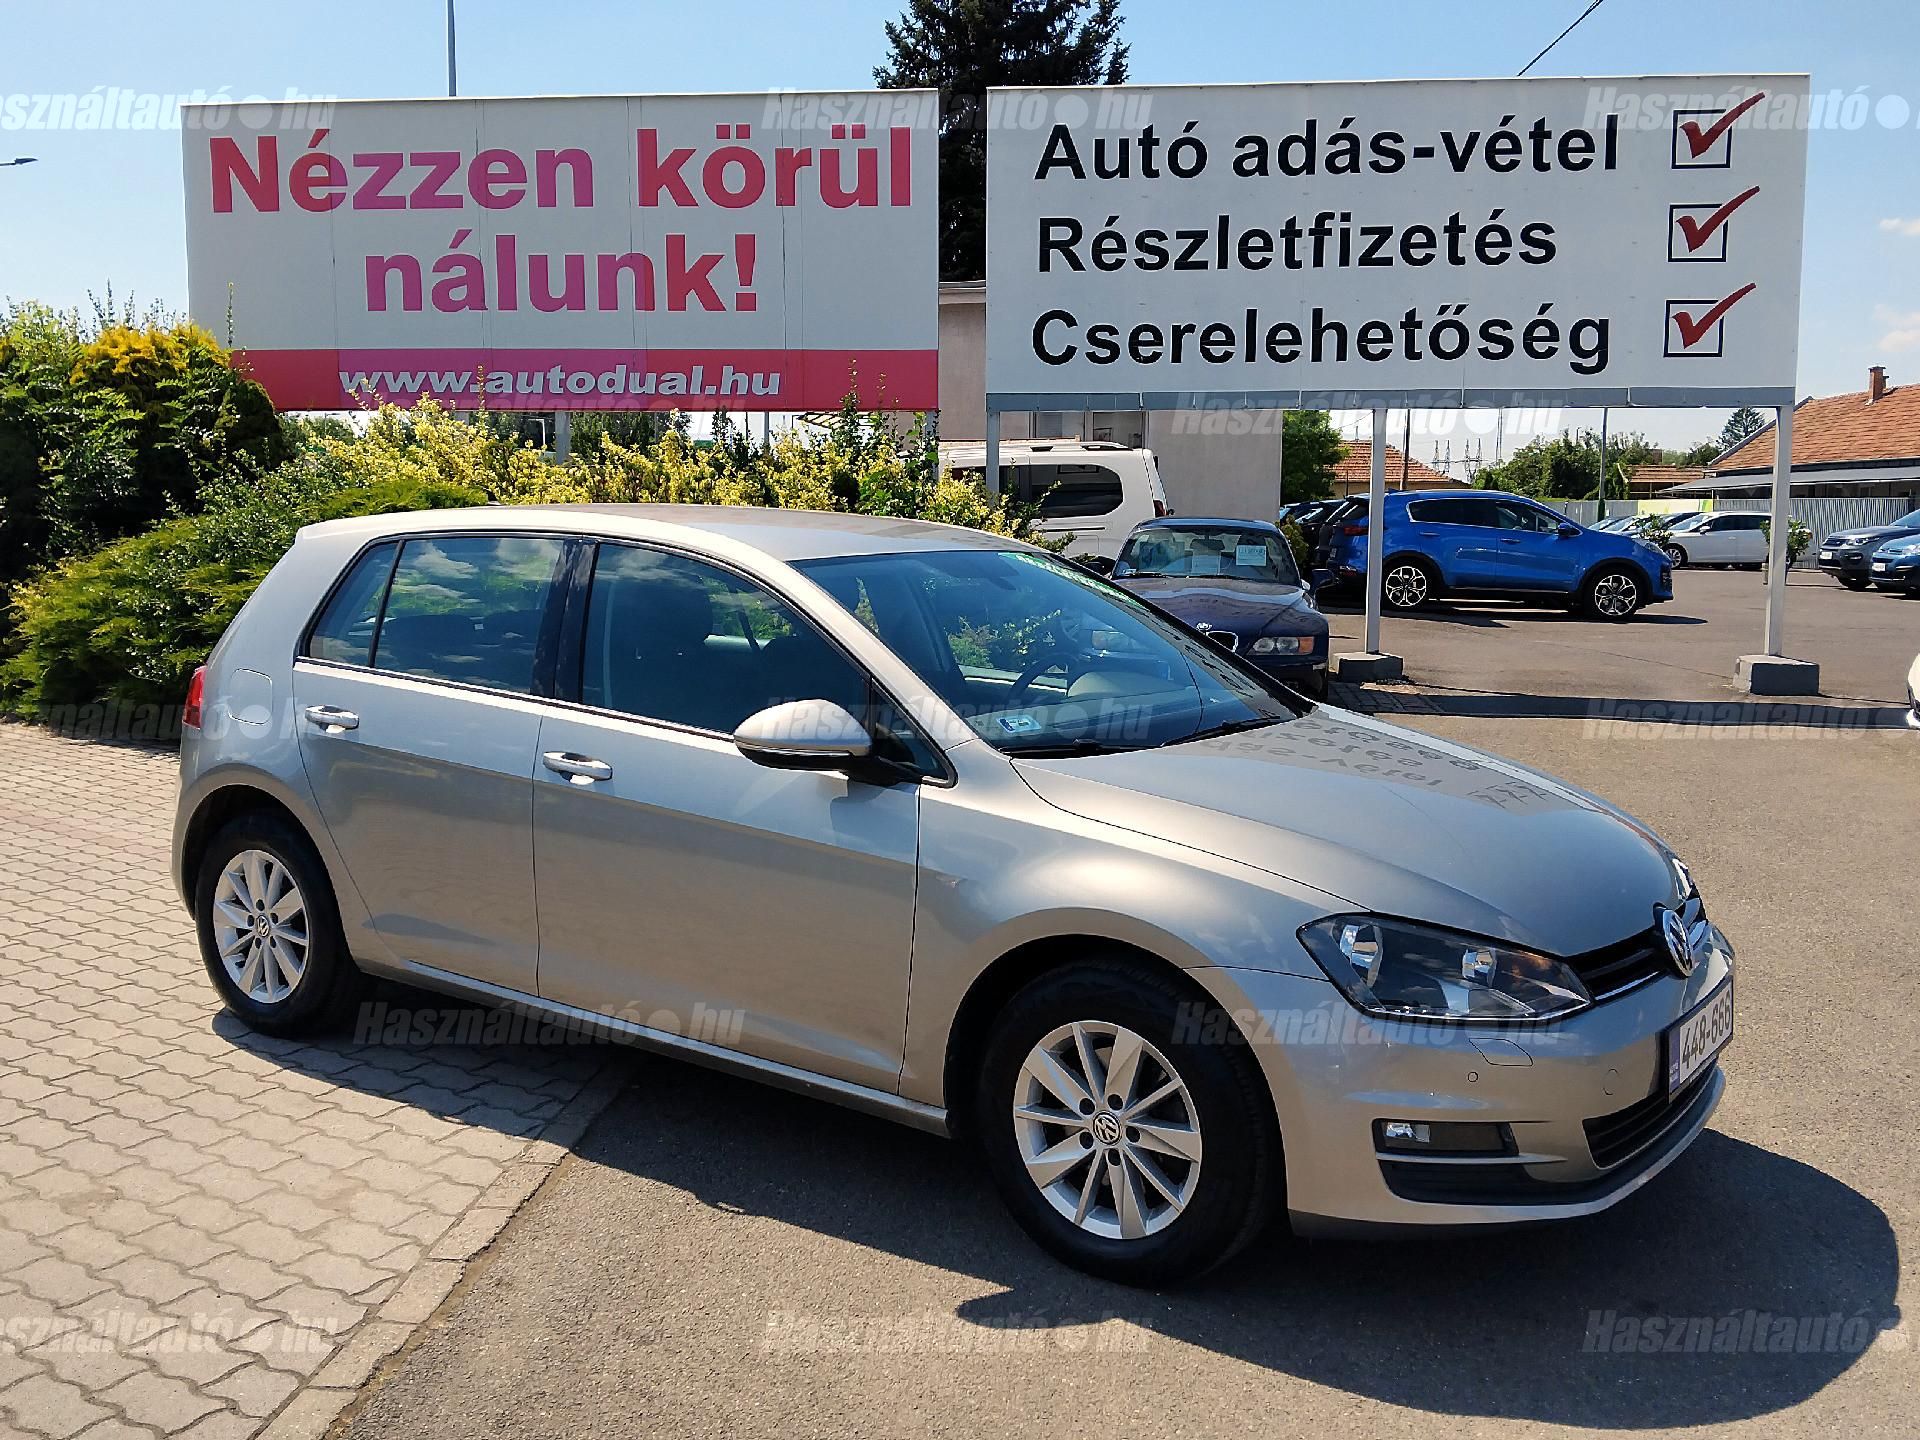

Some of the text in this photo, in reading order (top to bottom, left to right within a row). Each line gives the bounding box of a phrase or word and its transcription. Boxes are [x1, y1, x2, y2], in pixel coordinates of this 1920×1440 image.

[209, 124, 913, 214] Nézzen körül
[1034, 113, 1618, 181] Autó adás-vétel
[364, 228, 758, 313] nálunk!
[1037, 207, 1558, 273] Részletfizetés
[1031, 301, 1611, 376] Cserelehetőség
[338, 363, 781, 396] www.autodual.hu
